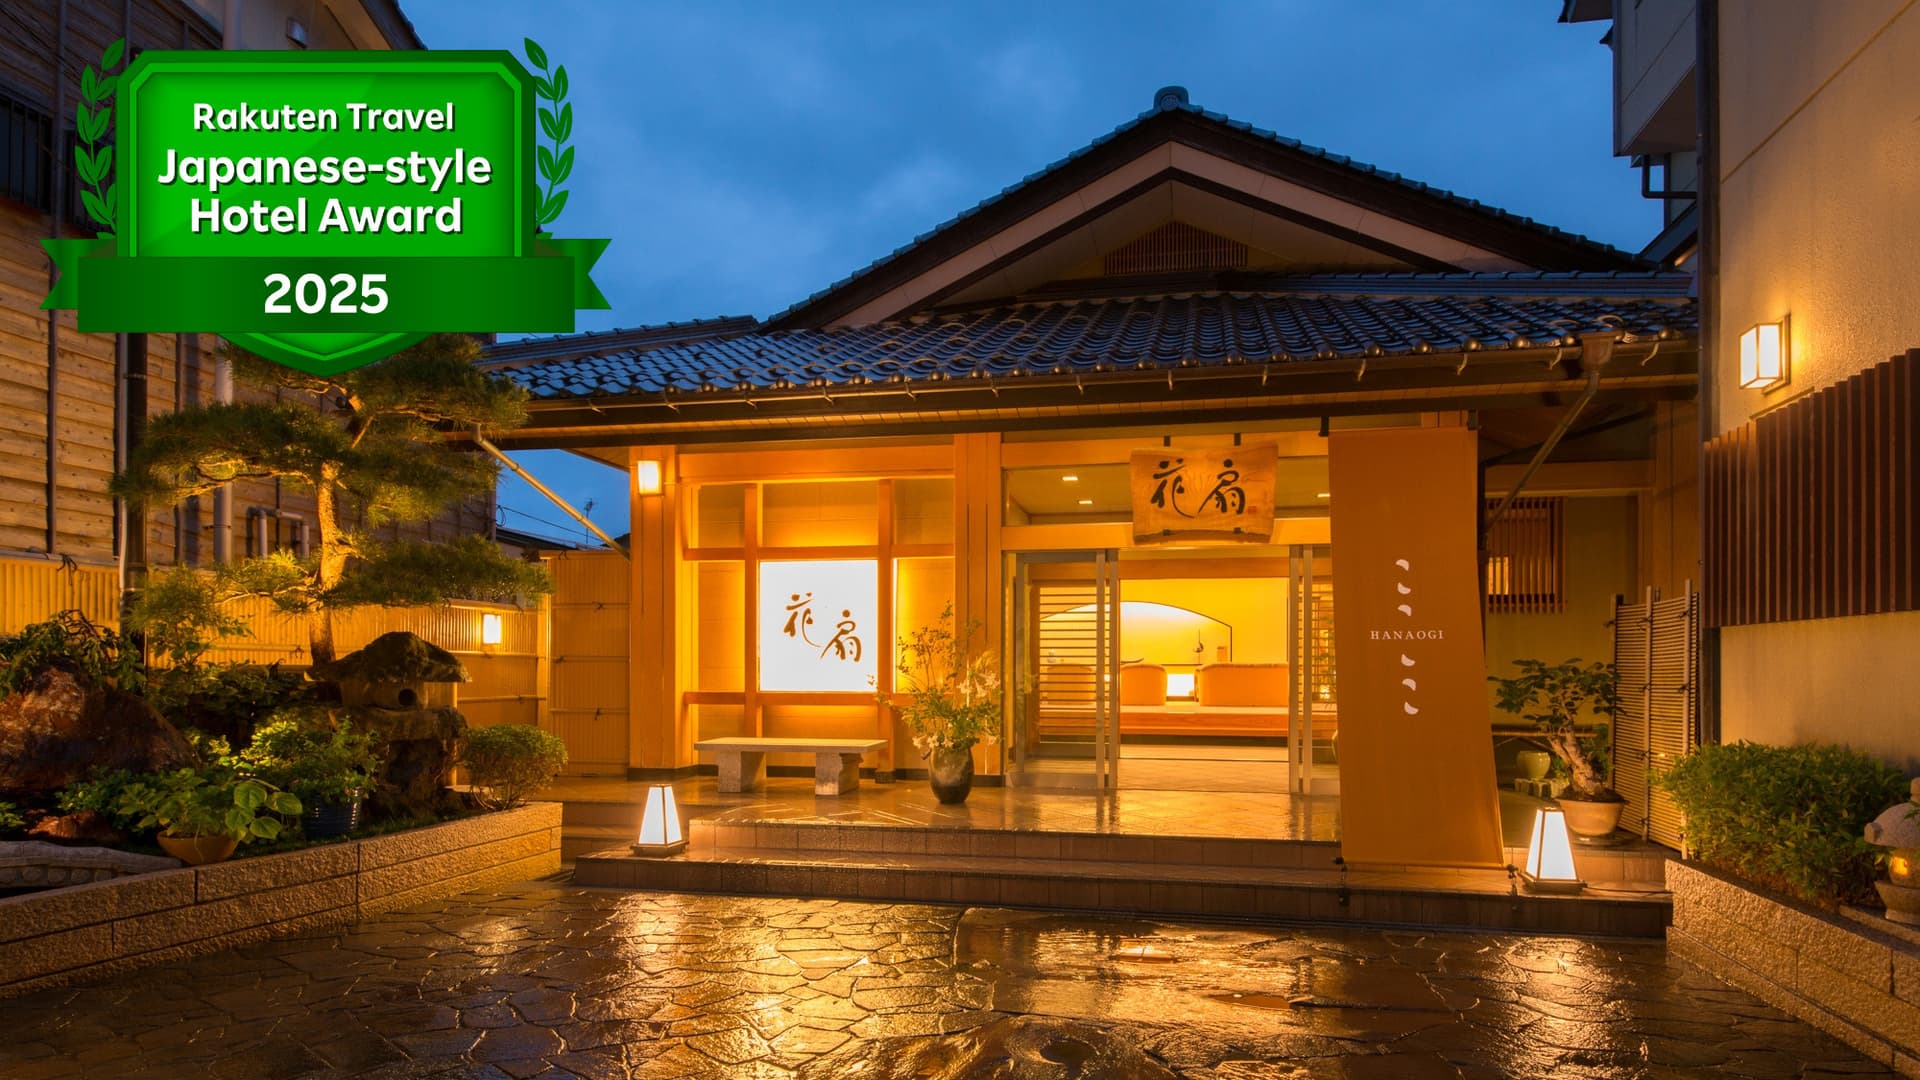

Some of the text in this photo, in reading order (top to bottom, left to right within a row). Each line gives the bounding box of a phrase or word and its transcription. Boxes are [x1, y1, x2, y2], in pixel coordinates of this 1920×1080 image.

[1151, 458, 1246, 518] 花扇
[783, 592, 862, 662] 花扇
[1370, 630, 1444, 640] HANAOGI
